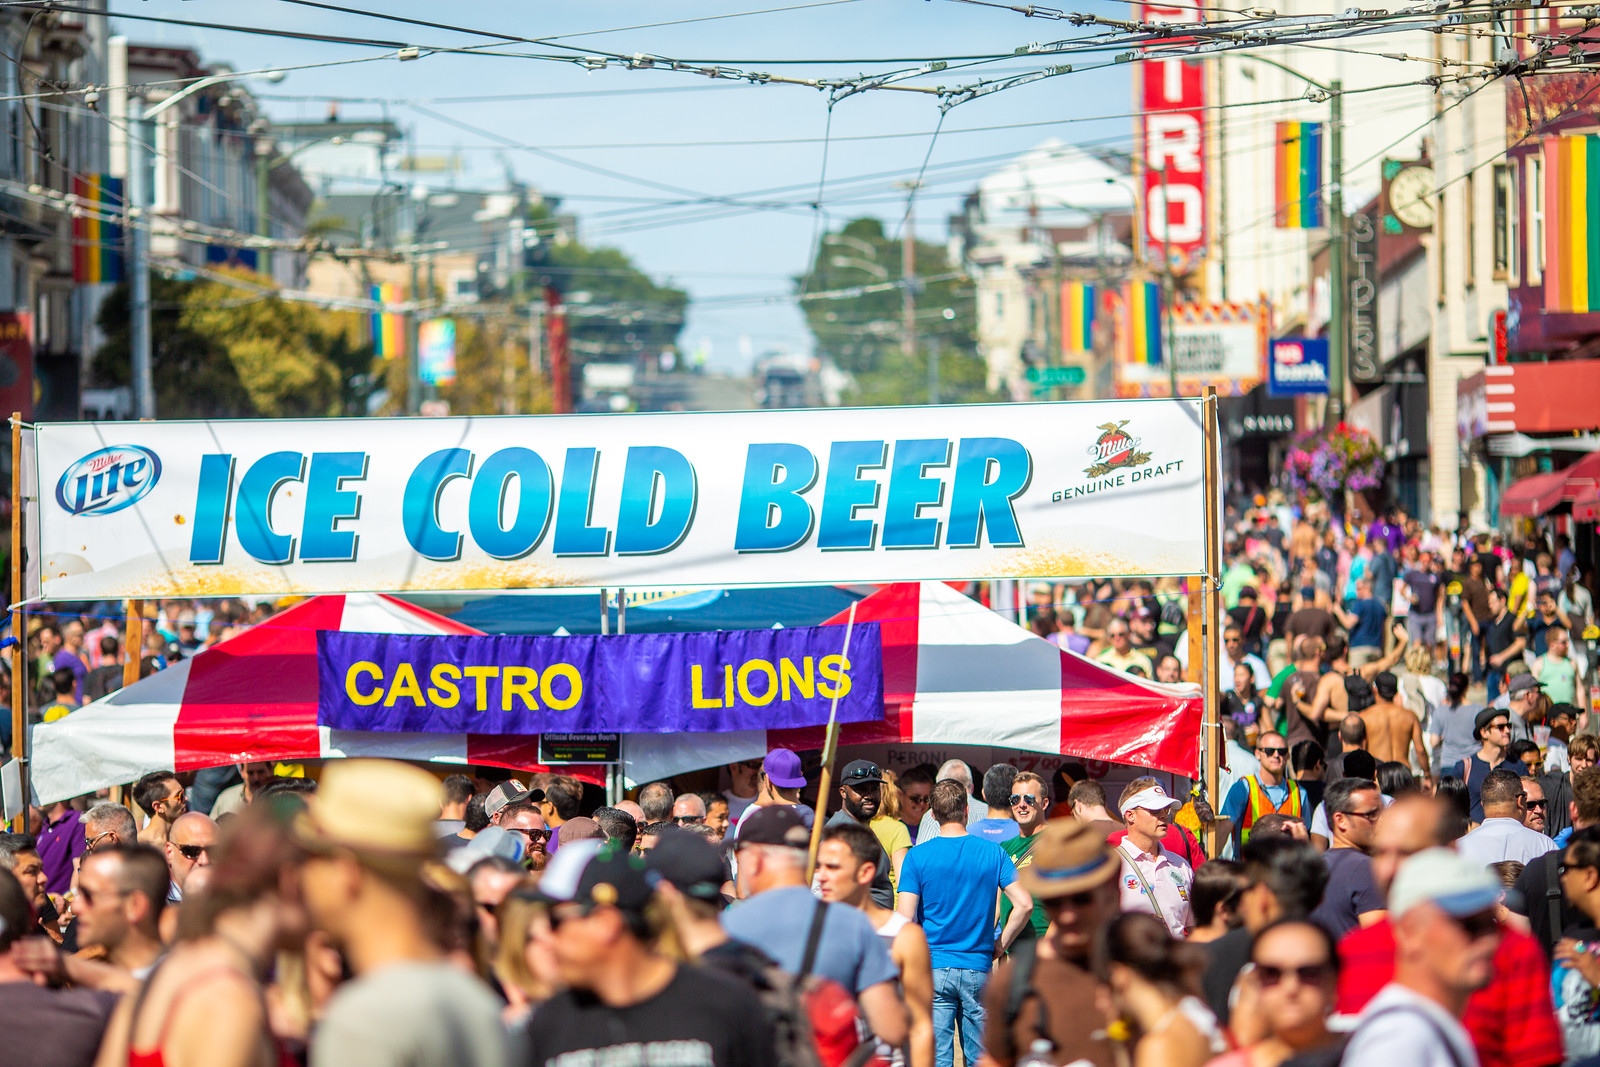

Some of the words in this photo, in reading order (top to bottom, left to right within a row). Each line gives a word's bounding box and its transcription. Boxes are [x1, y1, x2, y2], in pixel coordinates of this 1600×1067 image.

[1351, 212, 1377, 380] SLIDERS
[1274, 359, 1327, 382] bank
[1243, 414, 1294, 432] NAILS
[85, 453, 125, 472] Miller
[1086, 436, 1142, 466] Miller
[71, 457, 147, 517] Lite
[1052, 475, 1125, 503] GENUINE
[1131, 460, 1184, 482] DRAFT
[189, 450, 371, 565] ICE
[402, 446, 699, 562] COLD
[734, 437, 1034, 554] BEER
[345, 660, 583, 711] CASTRO
[691, 653, 853, 709] LIONS
[544, 733, 567, 741] Official
[568, 733, 597, 742] Beverage
[598, 733, 617, 741] Booth
[887, 749, 947, 766] PERONI
